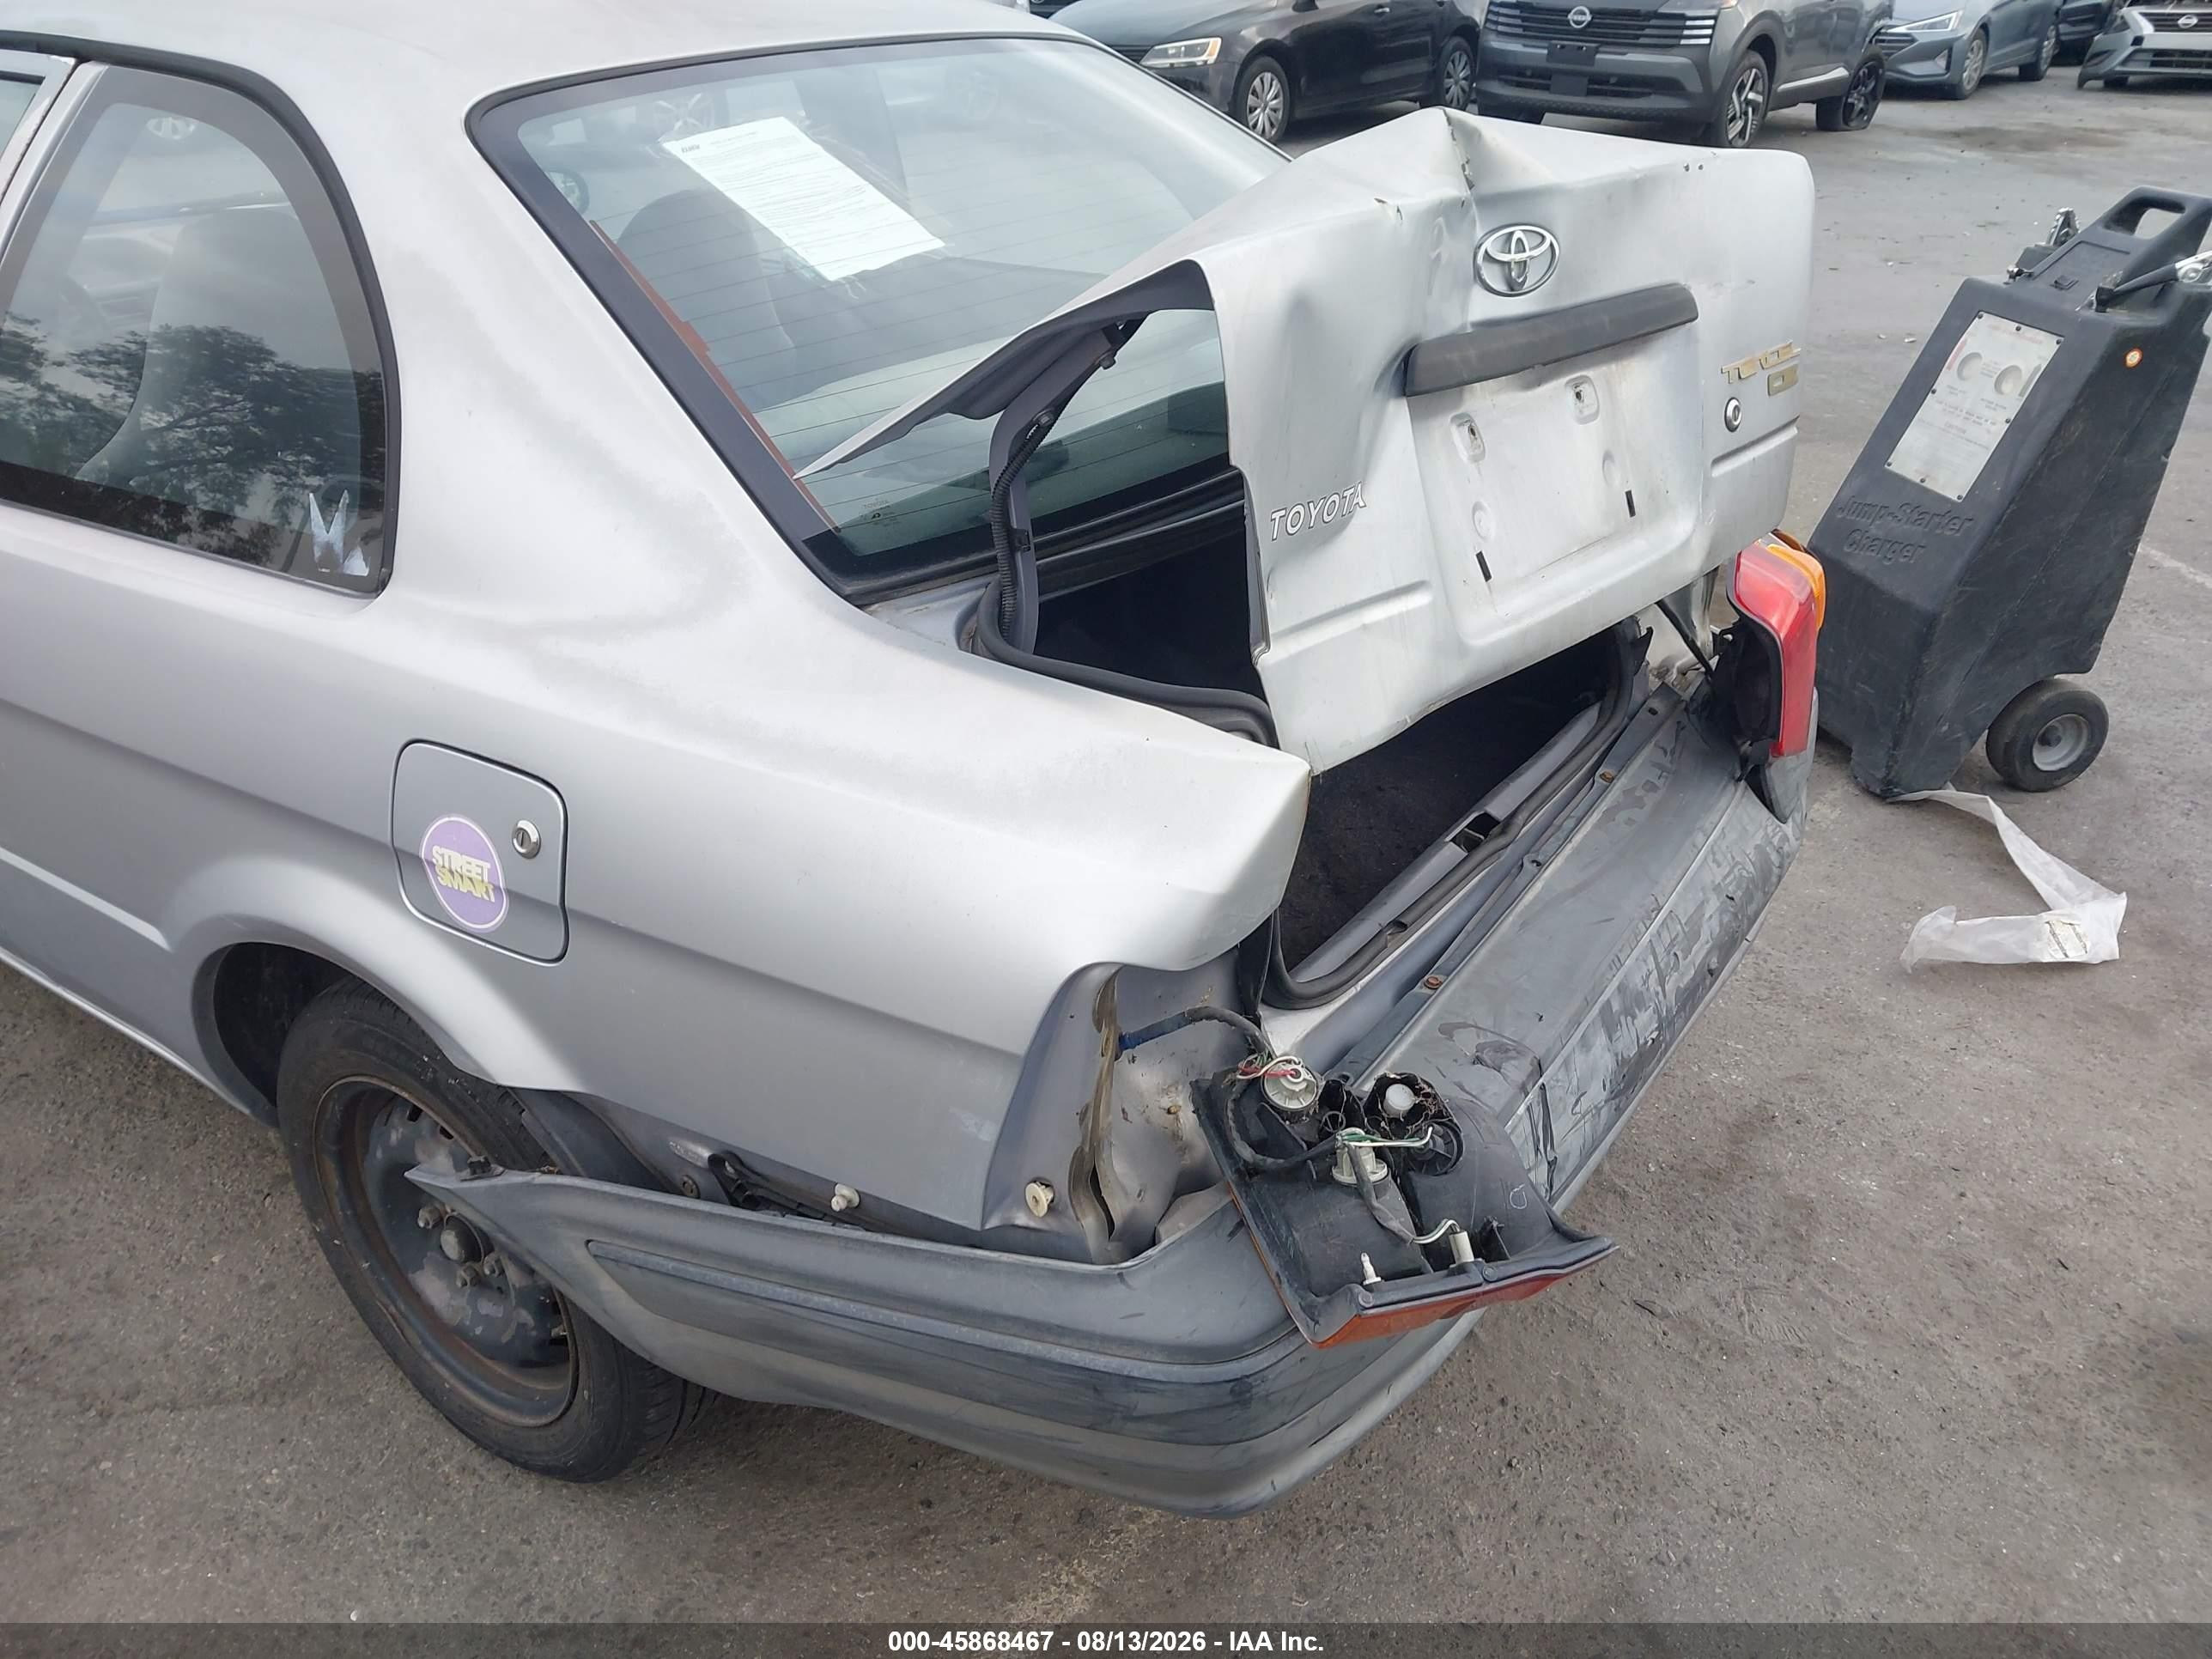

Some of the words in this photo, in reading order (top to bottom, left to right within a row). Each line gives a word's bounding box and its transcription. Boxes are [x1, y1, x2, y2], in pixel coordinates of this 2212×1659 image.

[1270, 481, 1367, 541] TOYOTA
[1837, 495, 1973, 536] Jump-Starter
[1844, 528, 1926, 564] Charger
[432, 845, 491, 884] STREET
